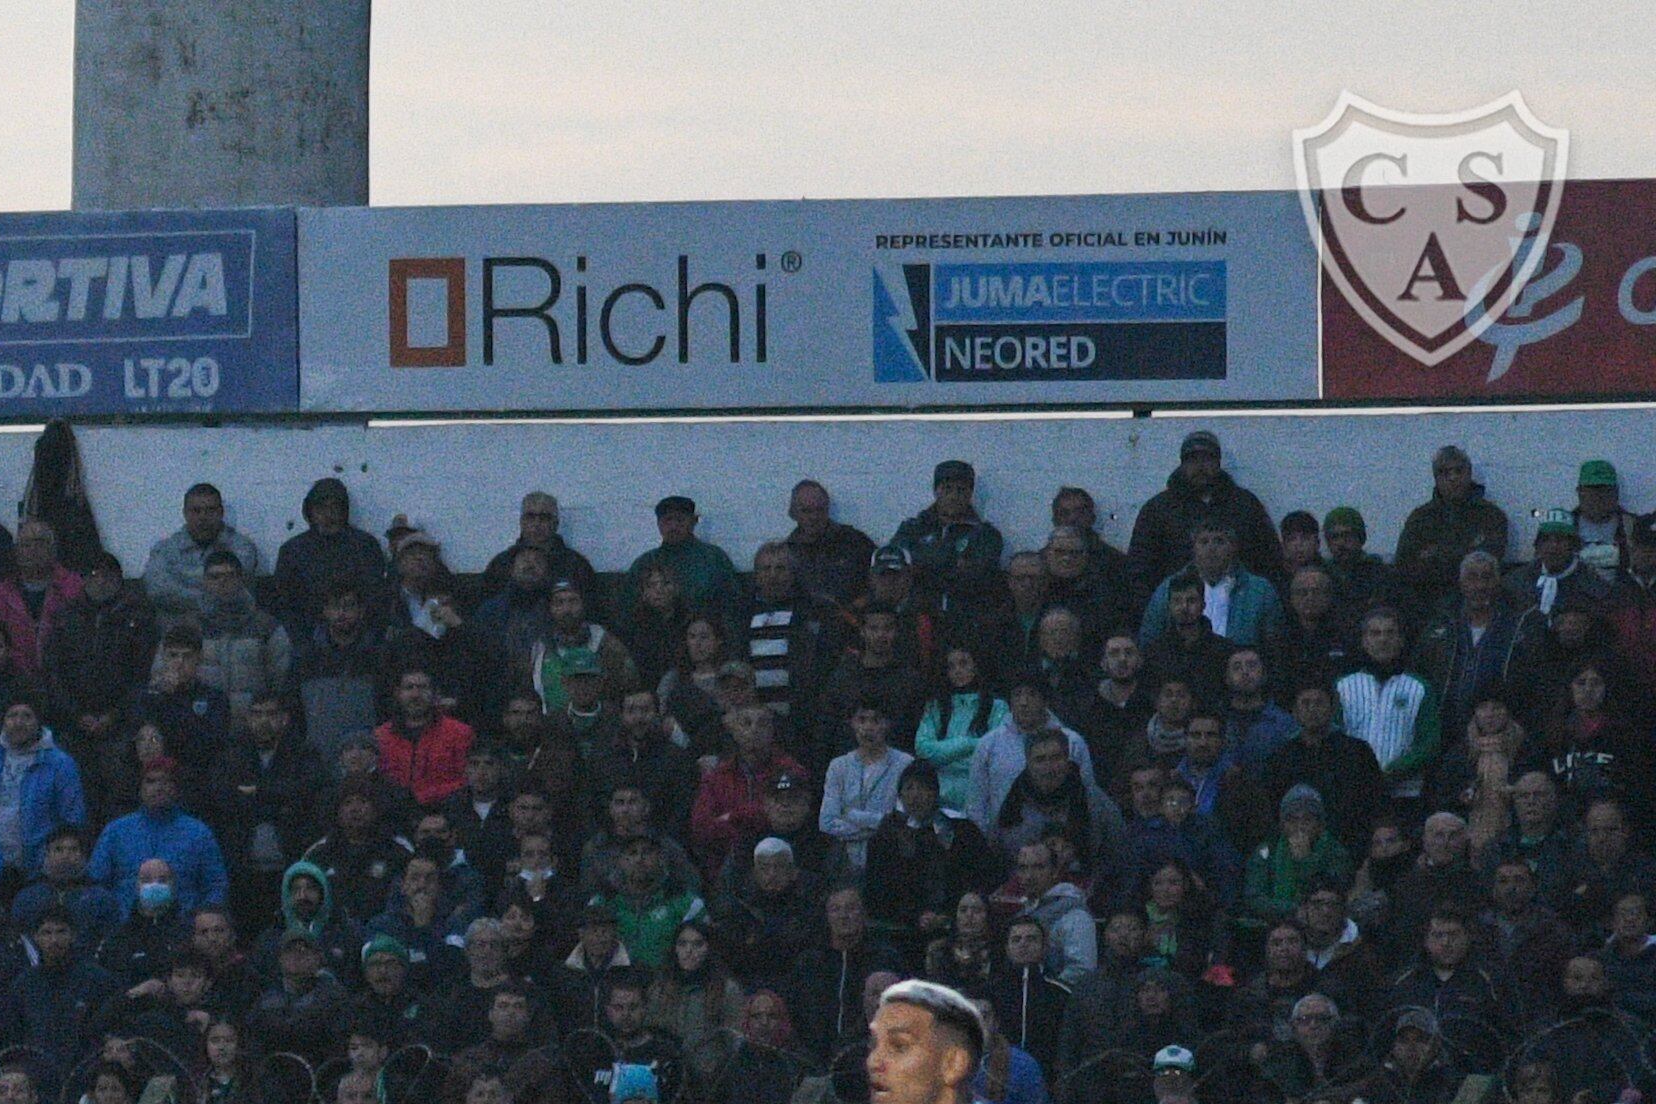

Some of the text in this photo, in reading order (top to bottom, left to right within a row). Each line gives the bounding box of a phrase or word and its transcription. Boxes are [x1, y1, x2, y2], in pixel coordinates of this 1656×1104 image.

[875, 229, 1228, 250] REPRESENTANTE OFICIAL EN JUNÍN
[945, 335, 1097, 371] NEORED
[124, 357, 220, 398] LT20
